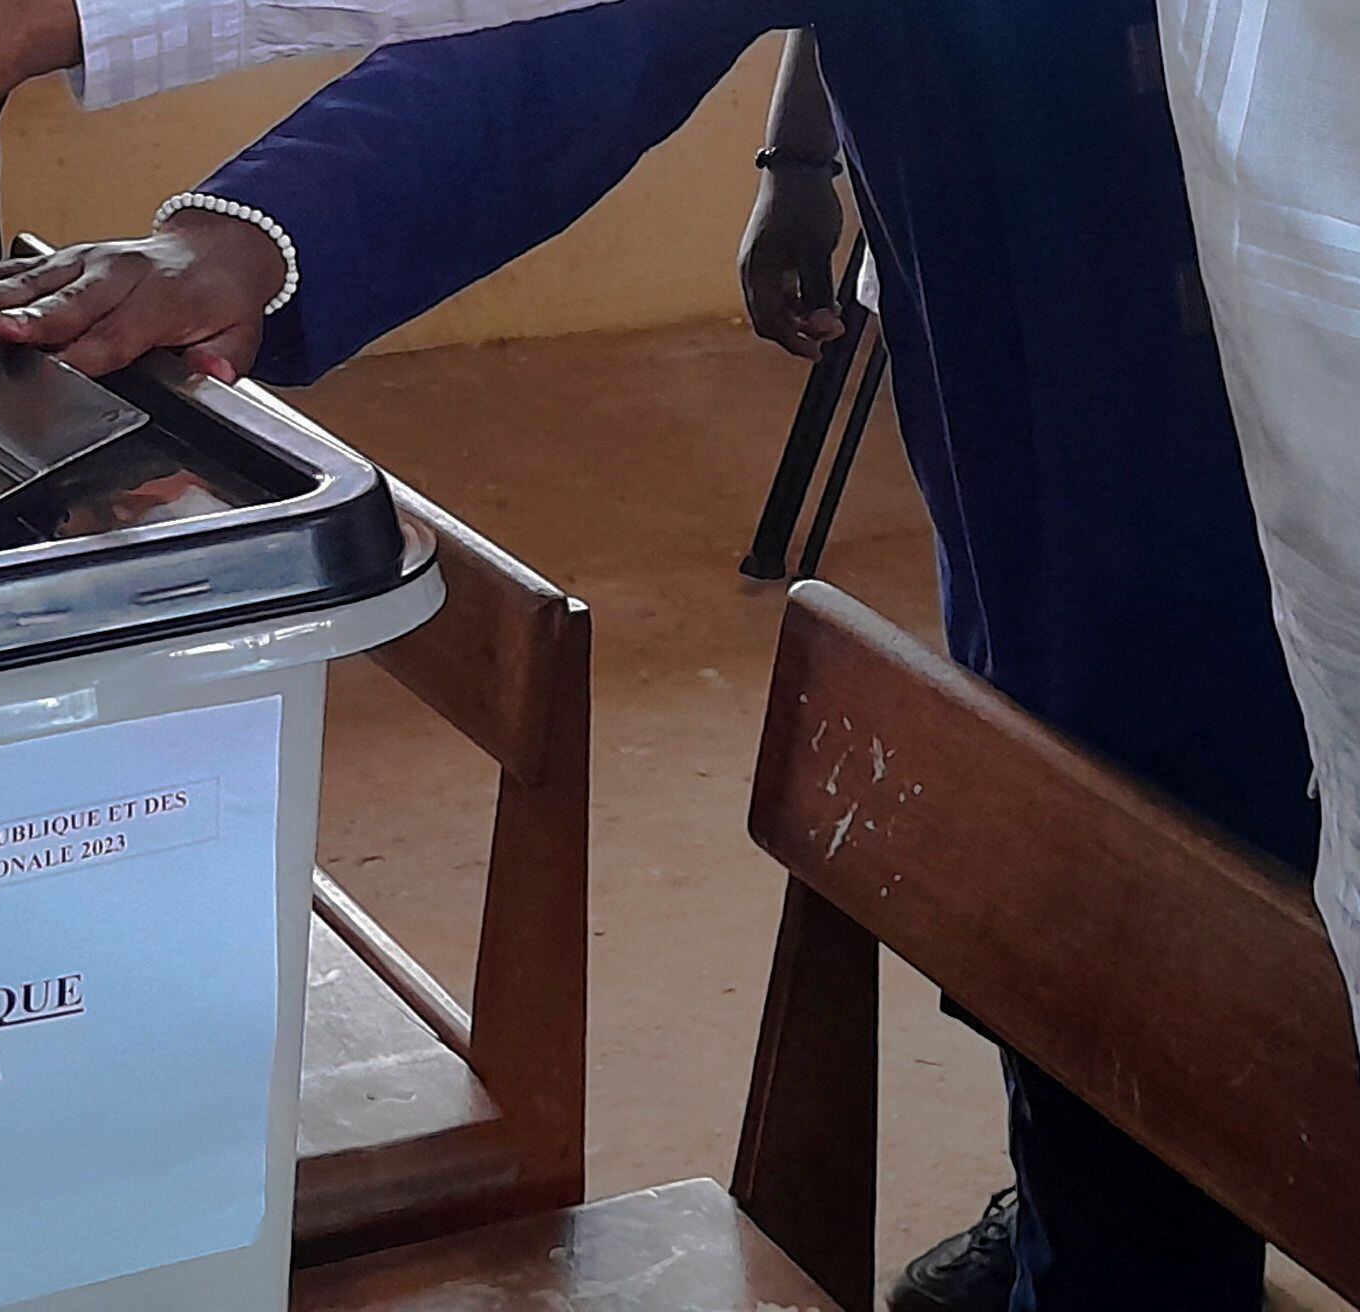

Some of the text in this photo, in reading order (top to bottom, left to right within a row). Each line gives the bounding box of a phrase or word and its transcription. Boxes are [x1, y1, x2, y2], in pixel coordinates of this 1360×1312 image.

[108, 800, 138, 822] ET
[144, 790, 188, 816] DES
[80, 834, 127, 860] 2023
